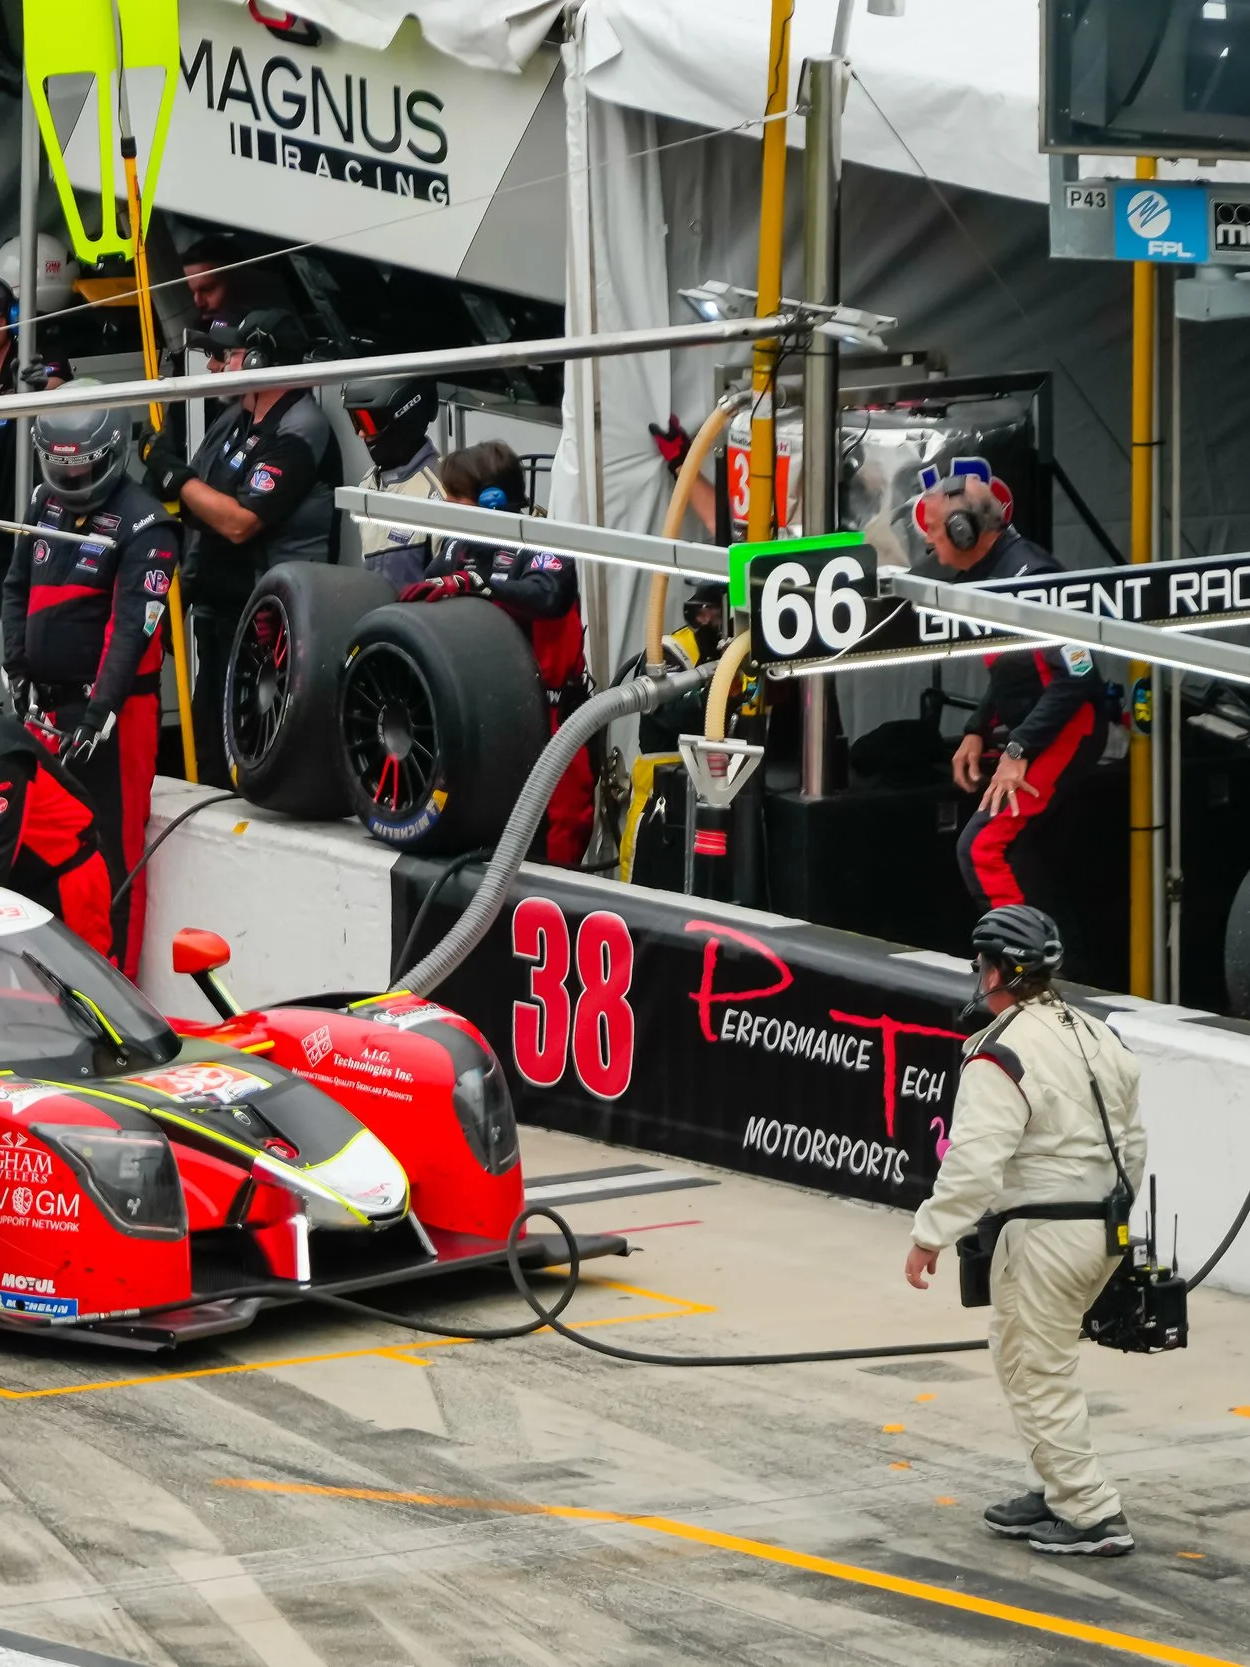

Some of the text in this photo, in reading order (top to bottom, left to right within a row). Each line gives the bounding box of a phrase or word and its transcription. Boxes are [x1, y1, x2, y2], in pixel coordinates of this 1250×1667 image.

[180, 38, 448, 164] MAGNUS
[283, 146, 448, 207] RACING
[1070, 191, 1106, 208] P43
[1148, 241, 1195, 258] FPL
[761, 556, 867, 656] 66
[512, 896, 635, 1100] 38
[333, 1053, 393, 1077] Technologies
[742, 1116, 909, 1184] MOTORSPORTS
[32, 1218, 80, 1232] NETWORK
[1, 1273, 56, 1295] MOTUL
[6, 1300, 69, 1314] MCHELIN
